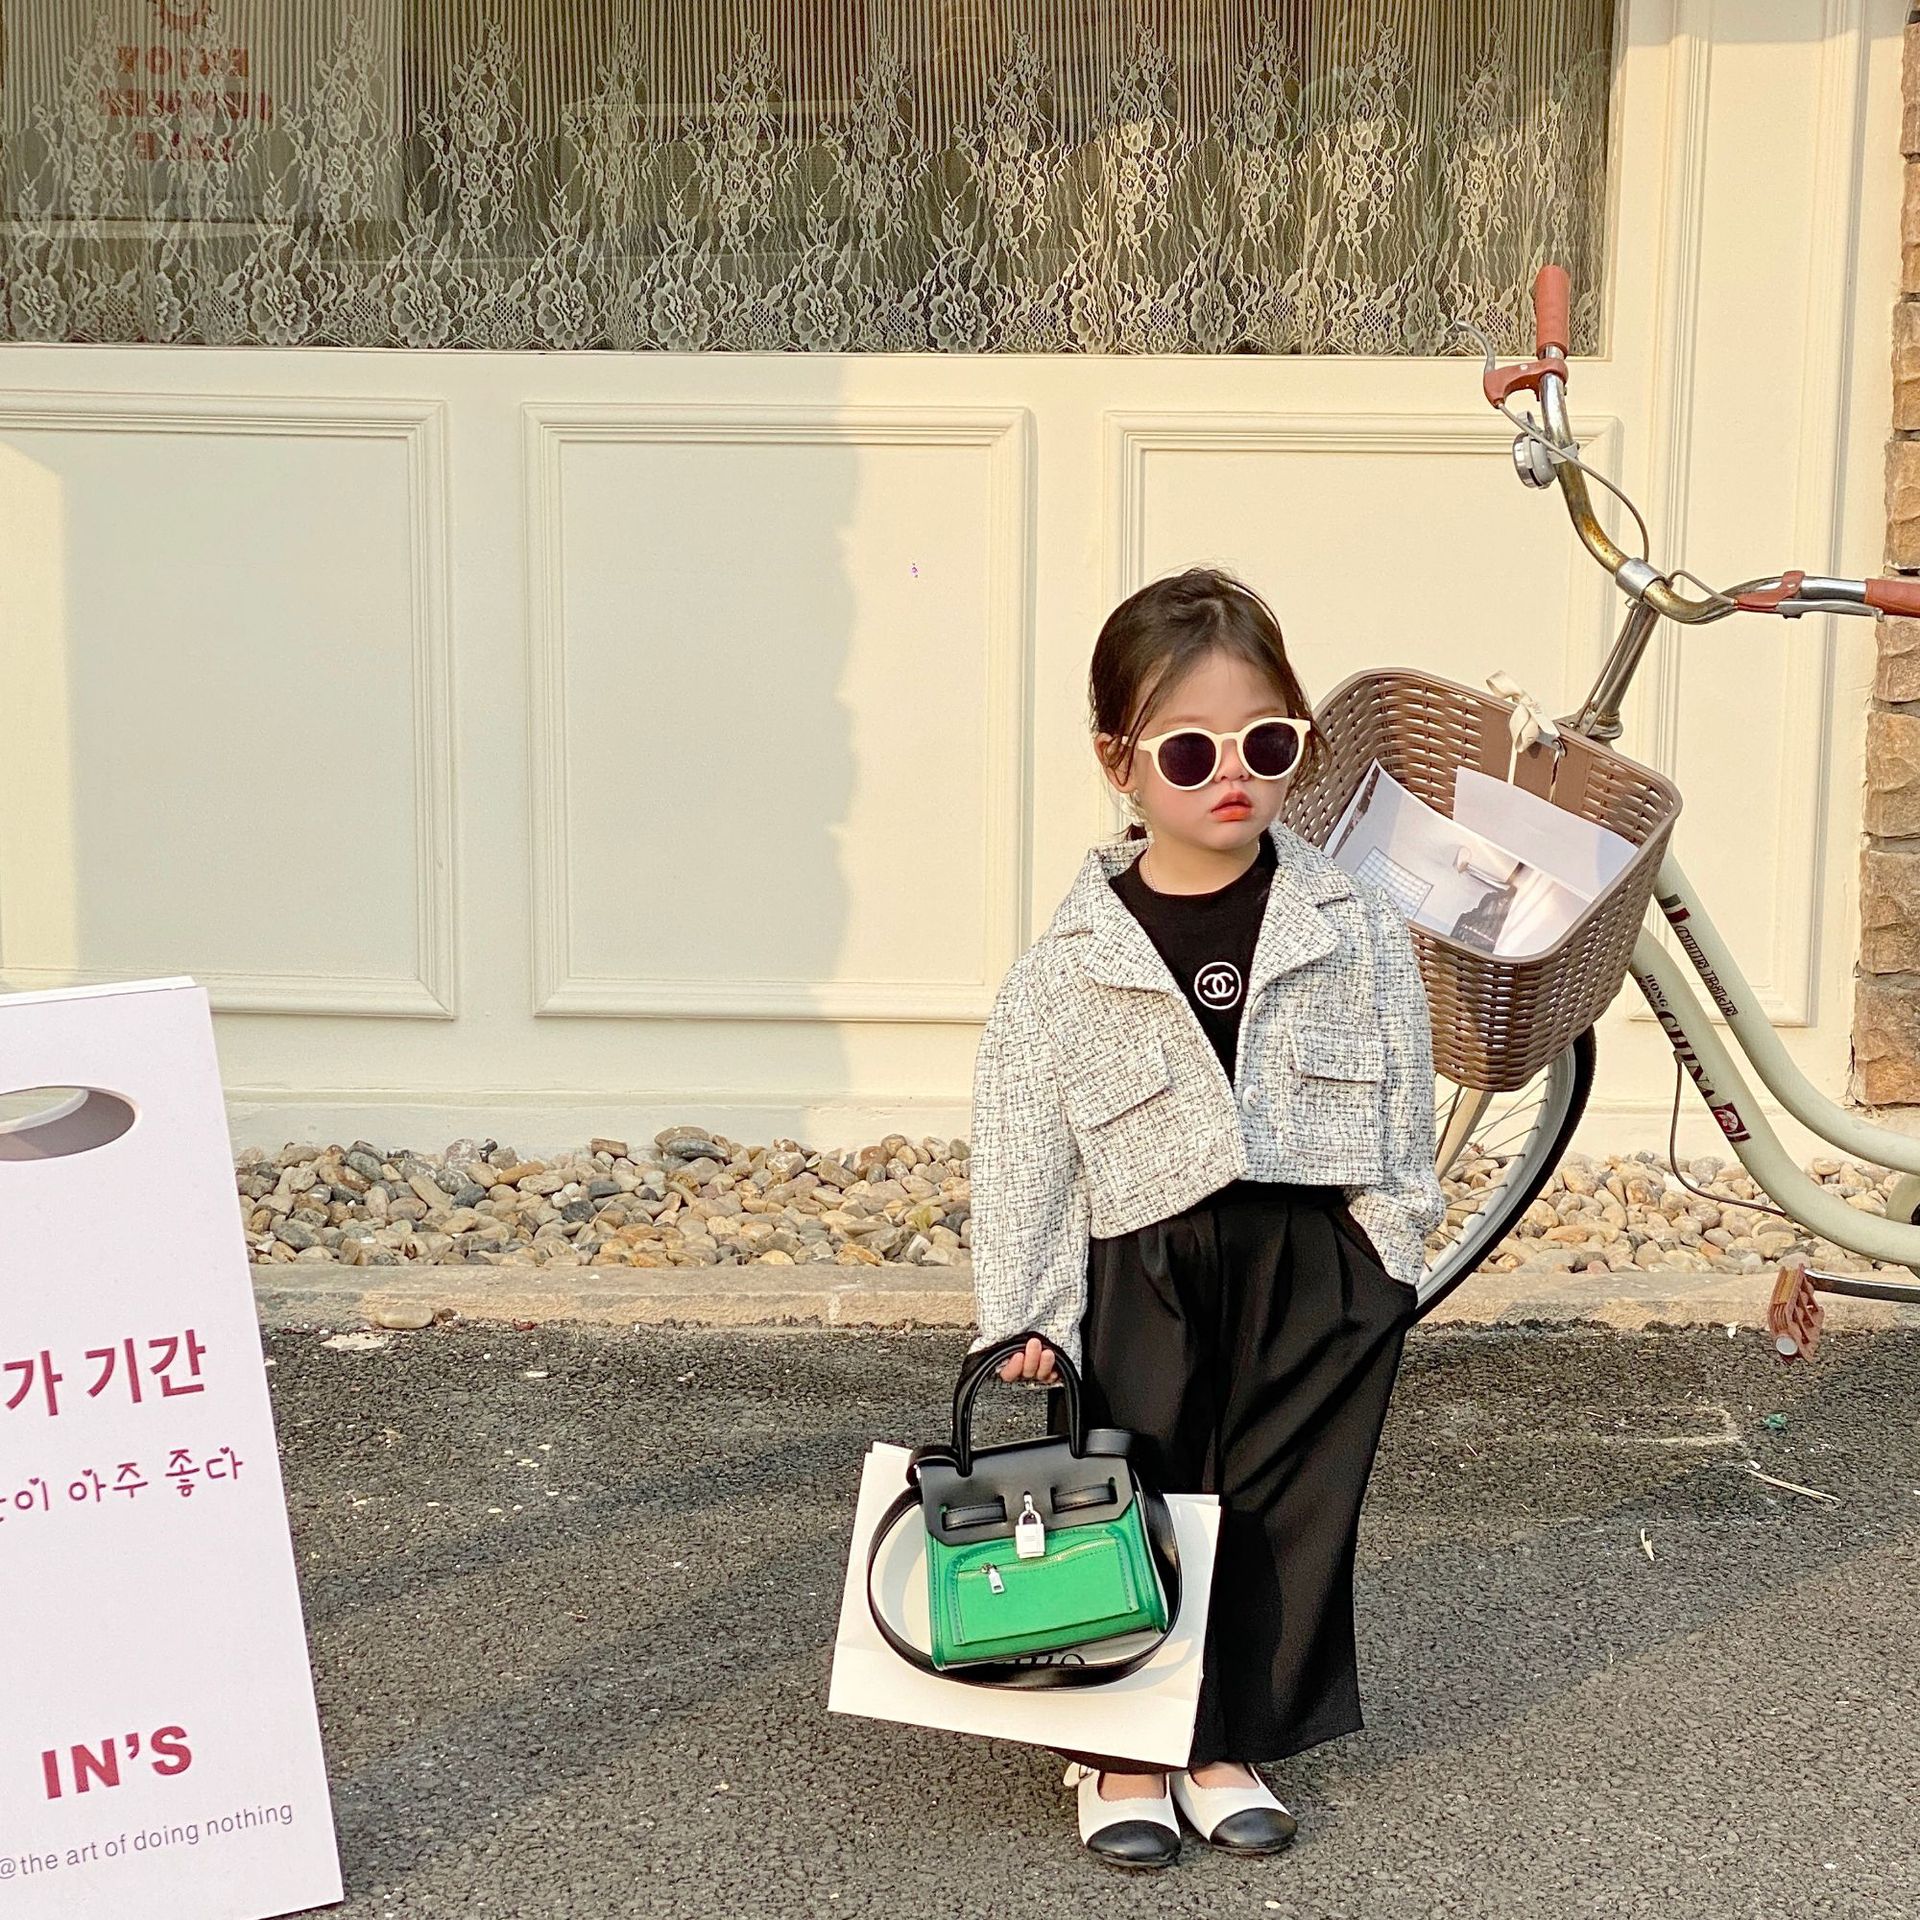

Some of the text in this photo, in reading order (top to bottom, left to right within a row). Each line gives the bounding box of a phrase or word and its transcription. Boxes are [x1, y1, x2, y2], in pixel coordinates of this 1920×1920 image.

[1656, 1010, 1715, 1099] CHINA
[85, 1328, 207, 1404] 기간
[0, 1447, 244, 1523] 이 아주 좋다
[41, 1725, 193, 1800] IN'S
[66, 1841, 99, 1867] art
[104, 1833, 127, 1858] of
[133, 1822, 200, 1852] doing
[206, 1804, 294, 1837] nothing
